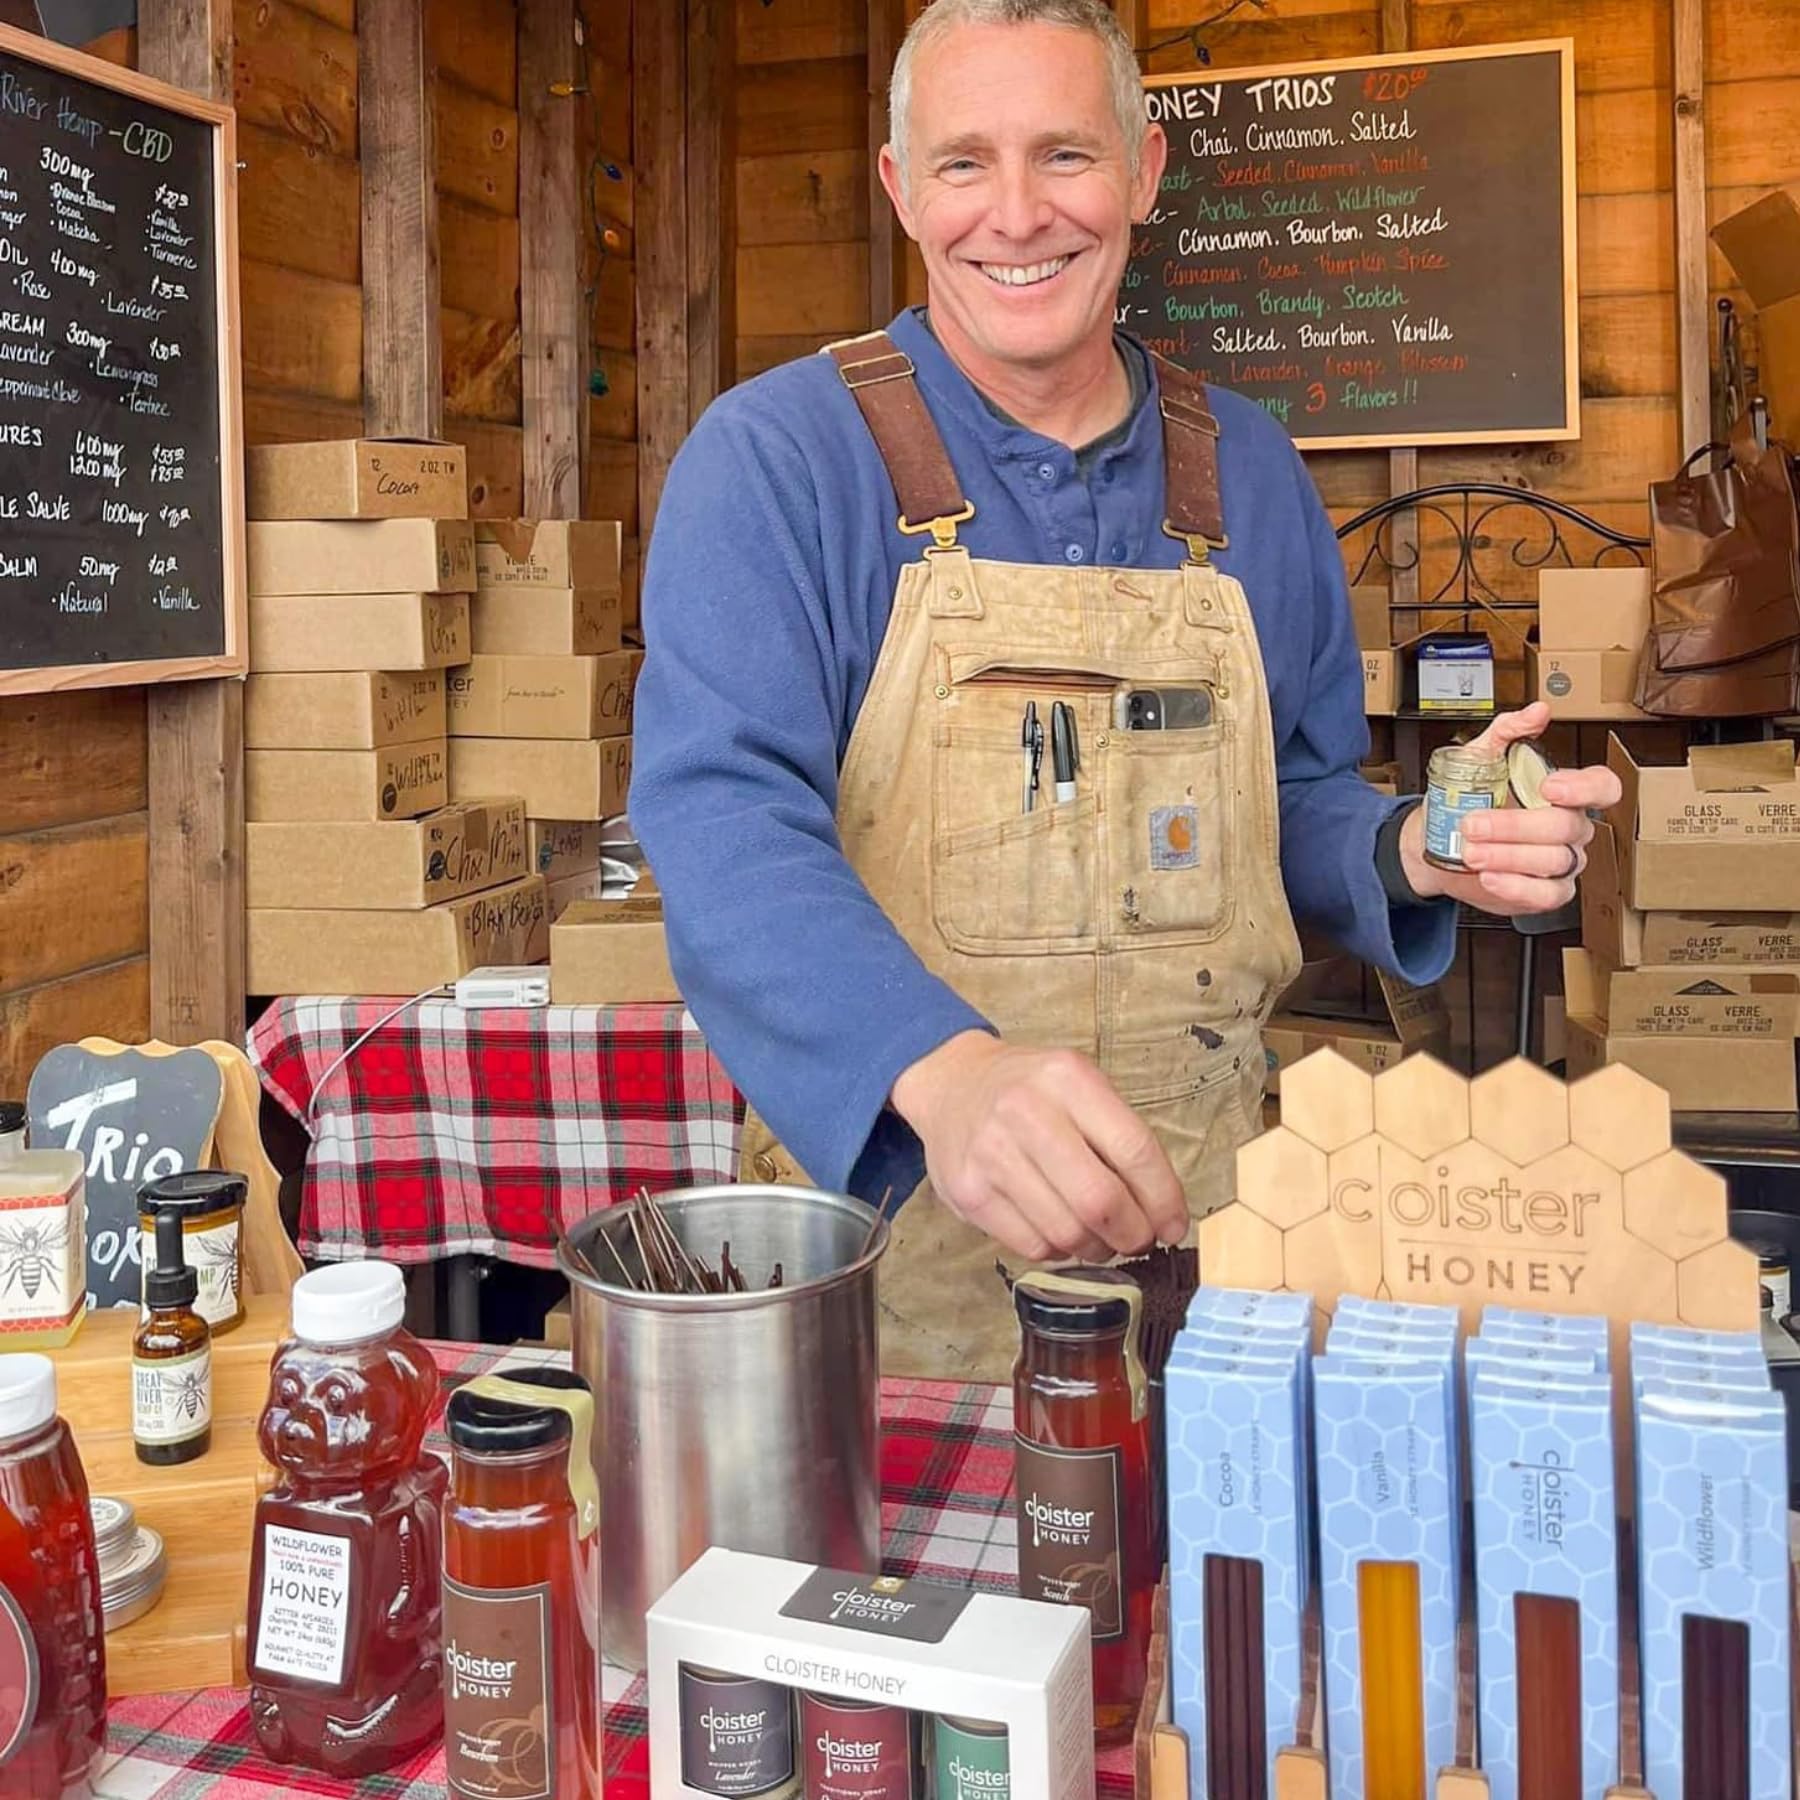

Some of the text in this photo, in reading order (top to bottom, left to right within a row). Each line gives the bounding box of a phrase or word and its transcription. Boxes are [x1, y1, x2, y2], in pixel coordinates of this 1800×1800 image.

[1144, 84, 1223, 121] ONEY
[1246, 76, 1336, 113] TRIOS
[1350, 109, 1417, 141] Salted
[1377, 207, 1448, 239] Salted
[150, 243, 197, 269] Turmeric
[21, 270, 166, 321] Rose Lavender
[1343, 284, 1408, 311] Scotch
[0, 311, 45, 338] REAM
[1392, 314, 1453, 344] Vanilla
[0, 342, 55, 366] avender
[1306, 383, 1327, 414] 3
[0, 424, 42, 447] URES
[59, 581, 200, 613] Natural Vanilla
[1684, 804, 1797, 816] GLASS VERRE
[1686, 935, 1794, 948] GLASS VERRE
[1654, 1006, 1761, 1017] GLASS VERRE
[1407, 1253, 1585, 1295] HONEY
[1219, 1451, 1233, 1507] Cocoa
[1371, 1450, 1390, 1505] Vanilla
[1521, 1473, 1536, 1541] HONEY
[1696, 1471, 1715, 1571] Wildflower
[271, 1534, 342, 1557] WILDFLOWER
[1040, 1528, 1090, 1545] HONEY
[280, 1559, 335, 1581] 100% PURE
[269, 1577, 343, 1609] HONEY
[831, 1587, 916, 1615] cloister
[844, 1607, 901, 1623] HONEY
[764, 1654, 906, 1695] CLOISTER HONEY
[459, 1681, 512, 1698] HONEY
[700, 1707, 766, 1733] cloister
[717, 1732, 763, 1745] HONEY
[816, 1730, 882, 1758] cloister
[833, 1761, 879, 1773] HONEY
